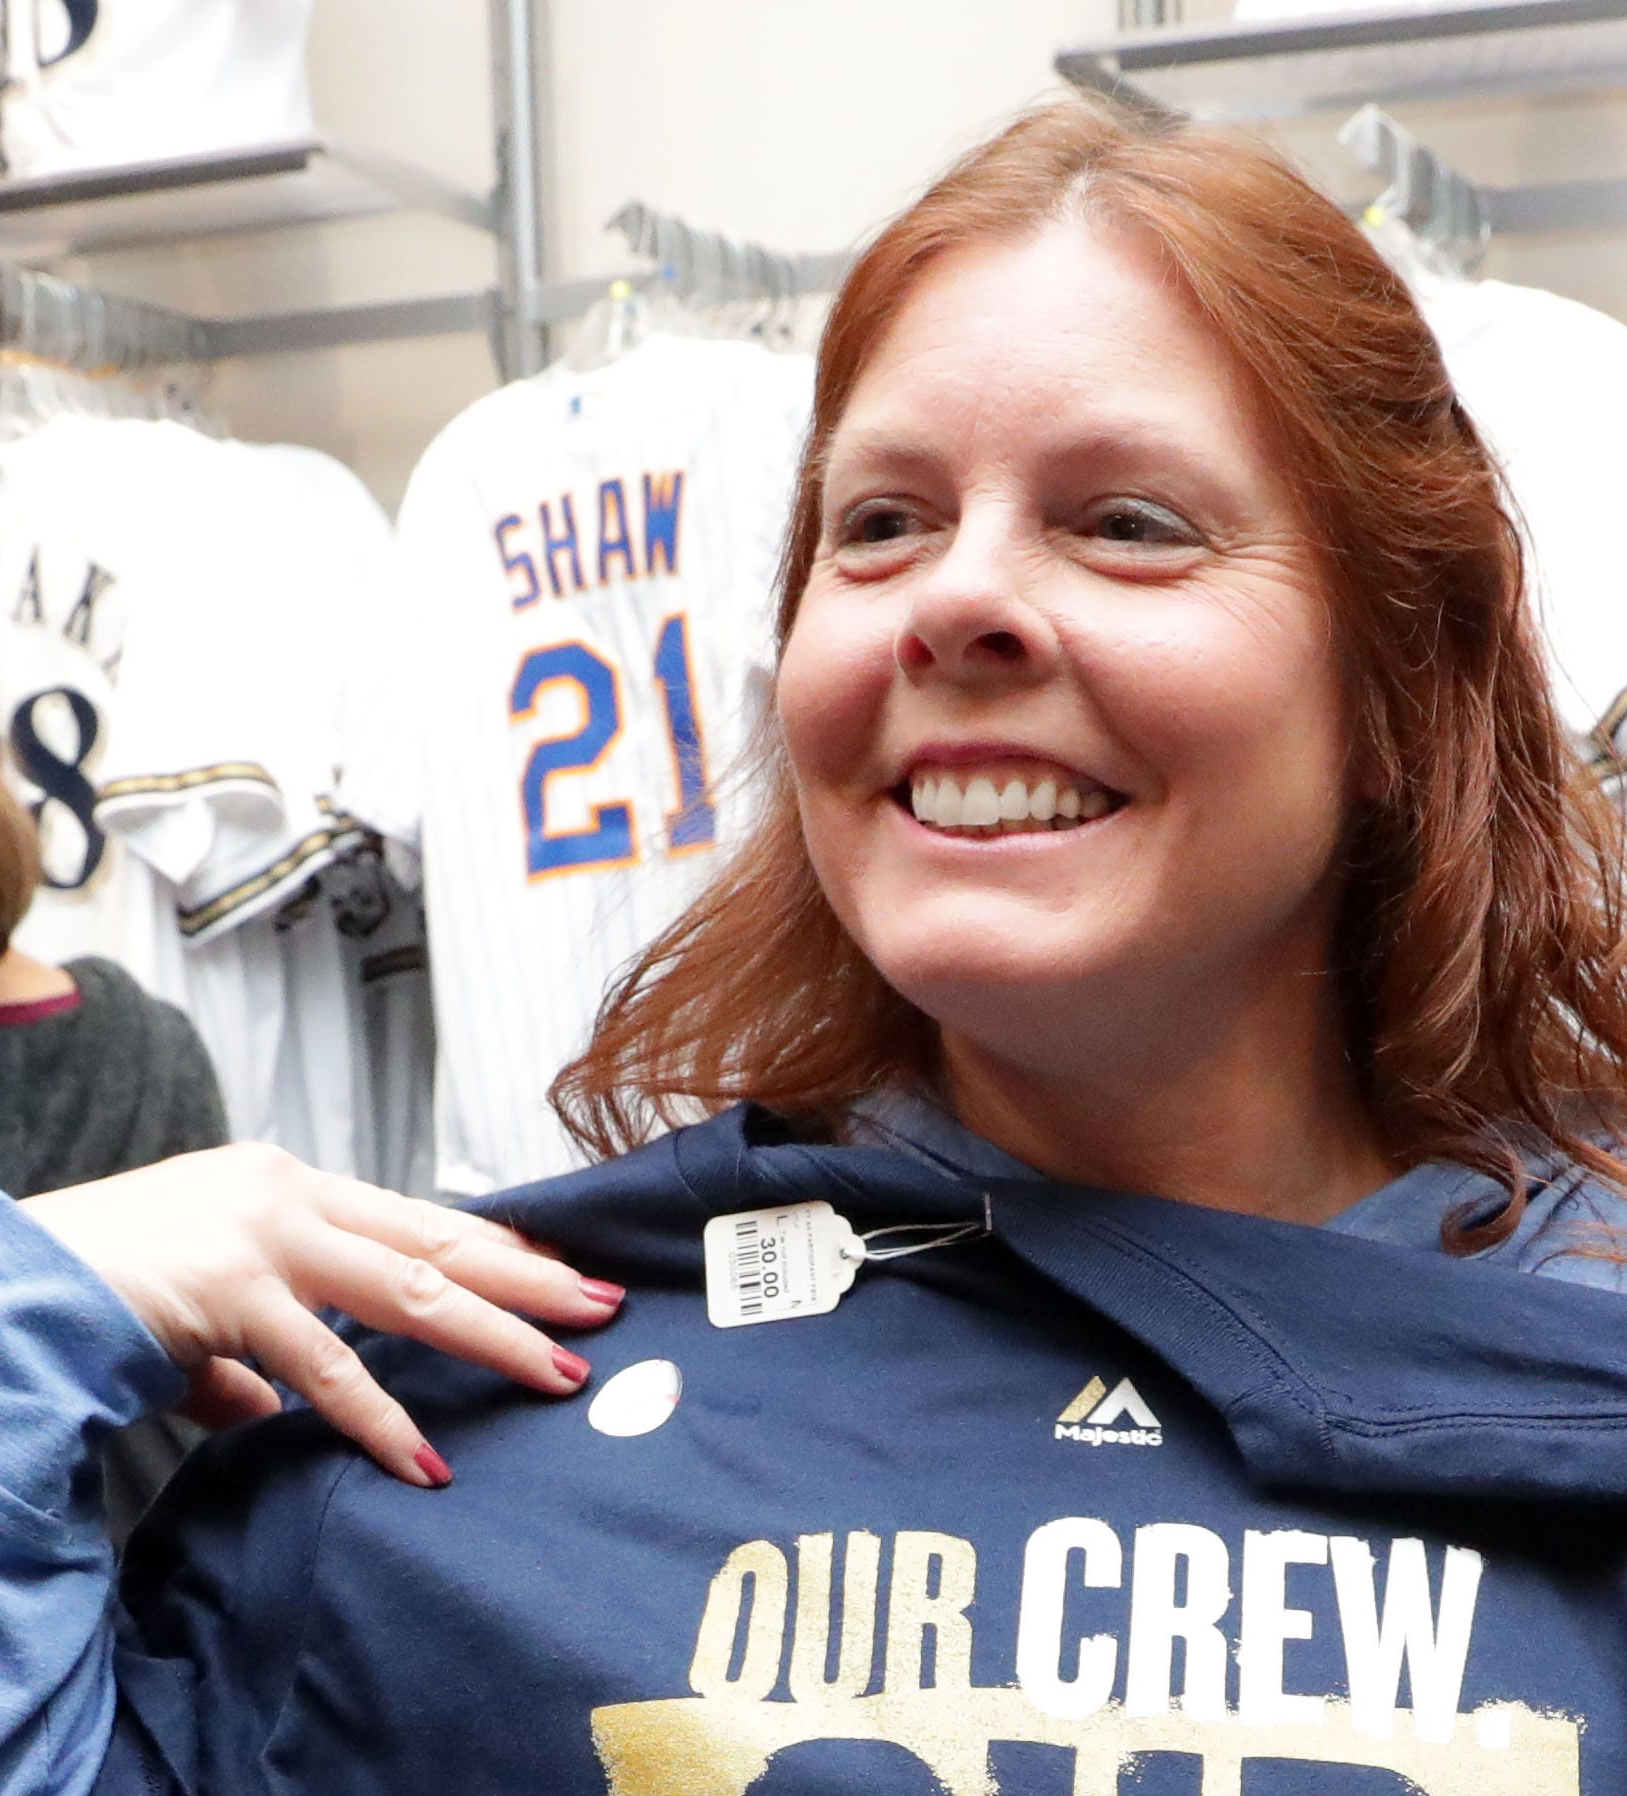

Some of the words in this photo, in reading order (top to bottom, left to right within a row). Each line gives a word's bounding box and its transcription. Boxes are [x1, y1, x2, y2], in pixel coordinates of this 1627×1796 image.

[491, 468, 687, 614] SHAW
[508, 609, 718, 886] 21
[760, 1237, 779, 1299] 30.00
[1054, 1423, 1164, 1447] Majestic
[689, 1529, 976, 1702] OUR
[1015, 1516, 1513, 1750] CREW.
